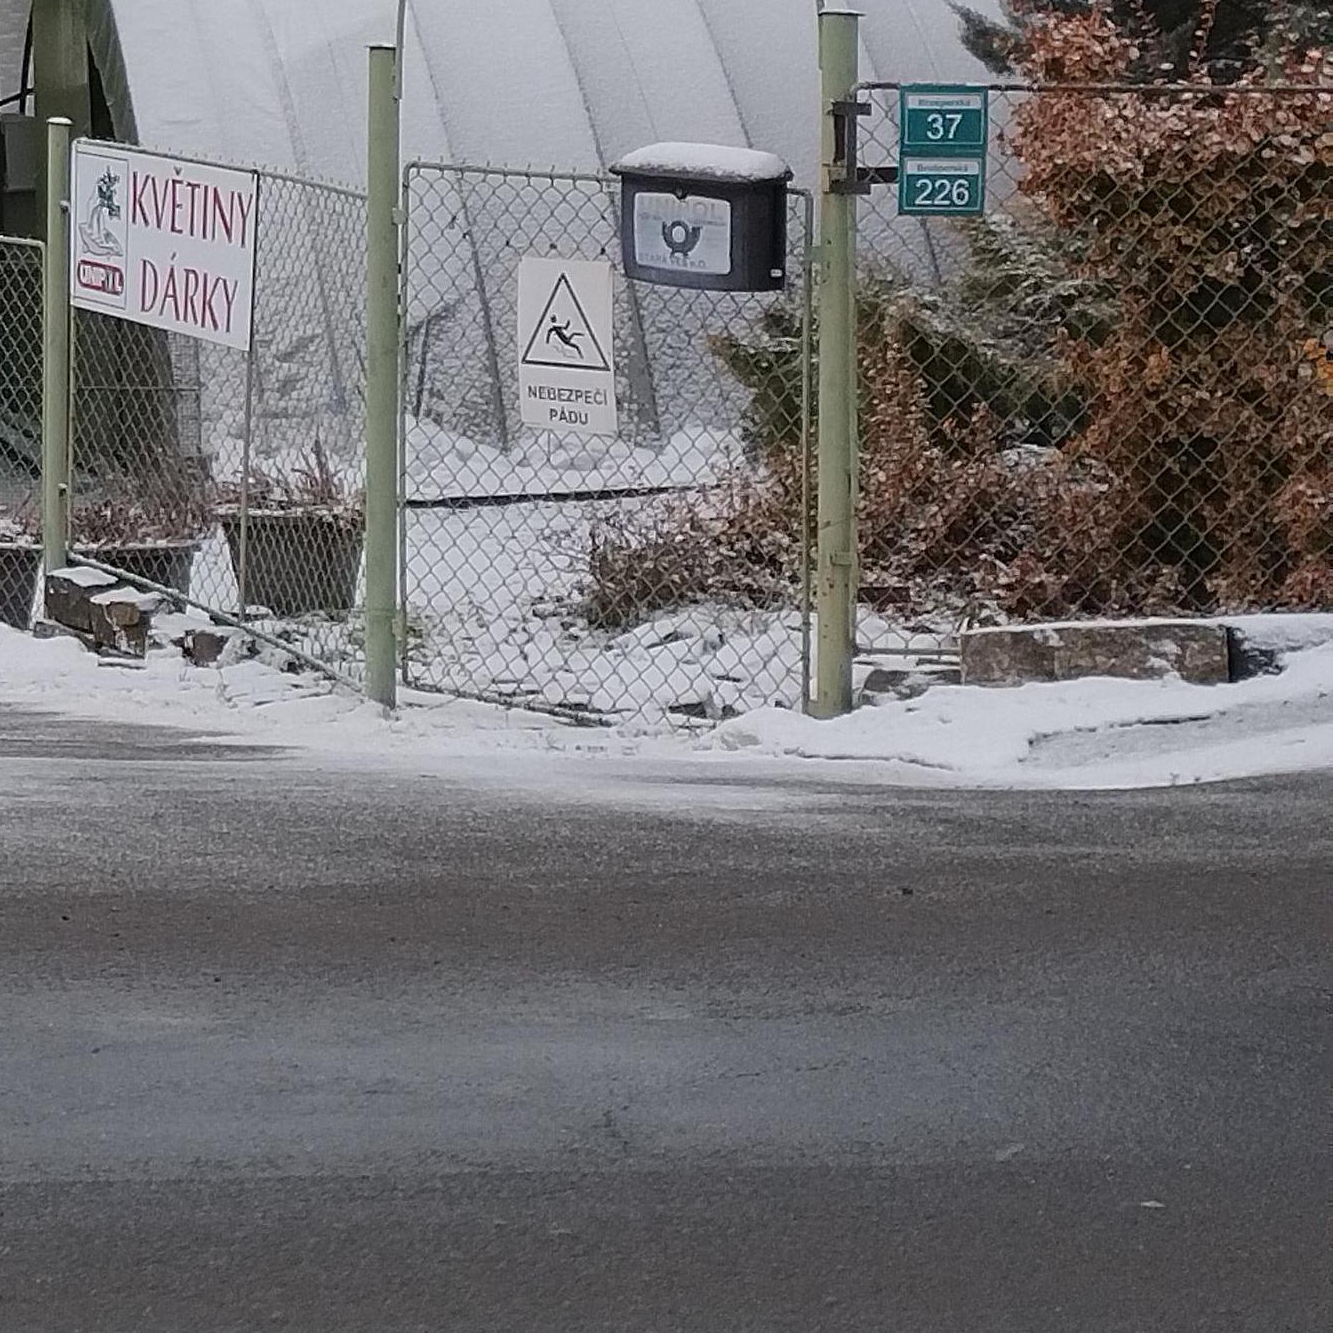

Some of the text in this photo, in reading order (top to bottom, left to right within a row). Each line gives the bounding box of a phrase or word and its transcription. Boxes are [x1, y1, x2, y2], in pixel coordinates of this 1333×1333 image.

[926, 113, 963, 140] 37
[914, 178, 970, 206] 226
[132, 166, 253, 249] KVĚTINY
[140, 252, 238, 333] DÁRKY
[549, 406, 589, 425] PÁDU
